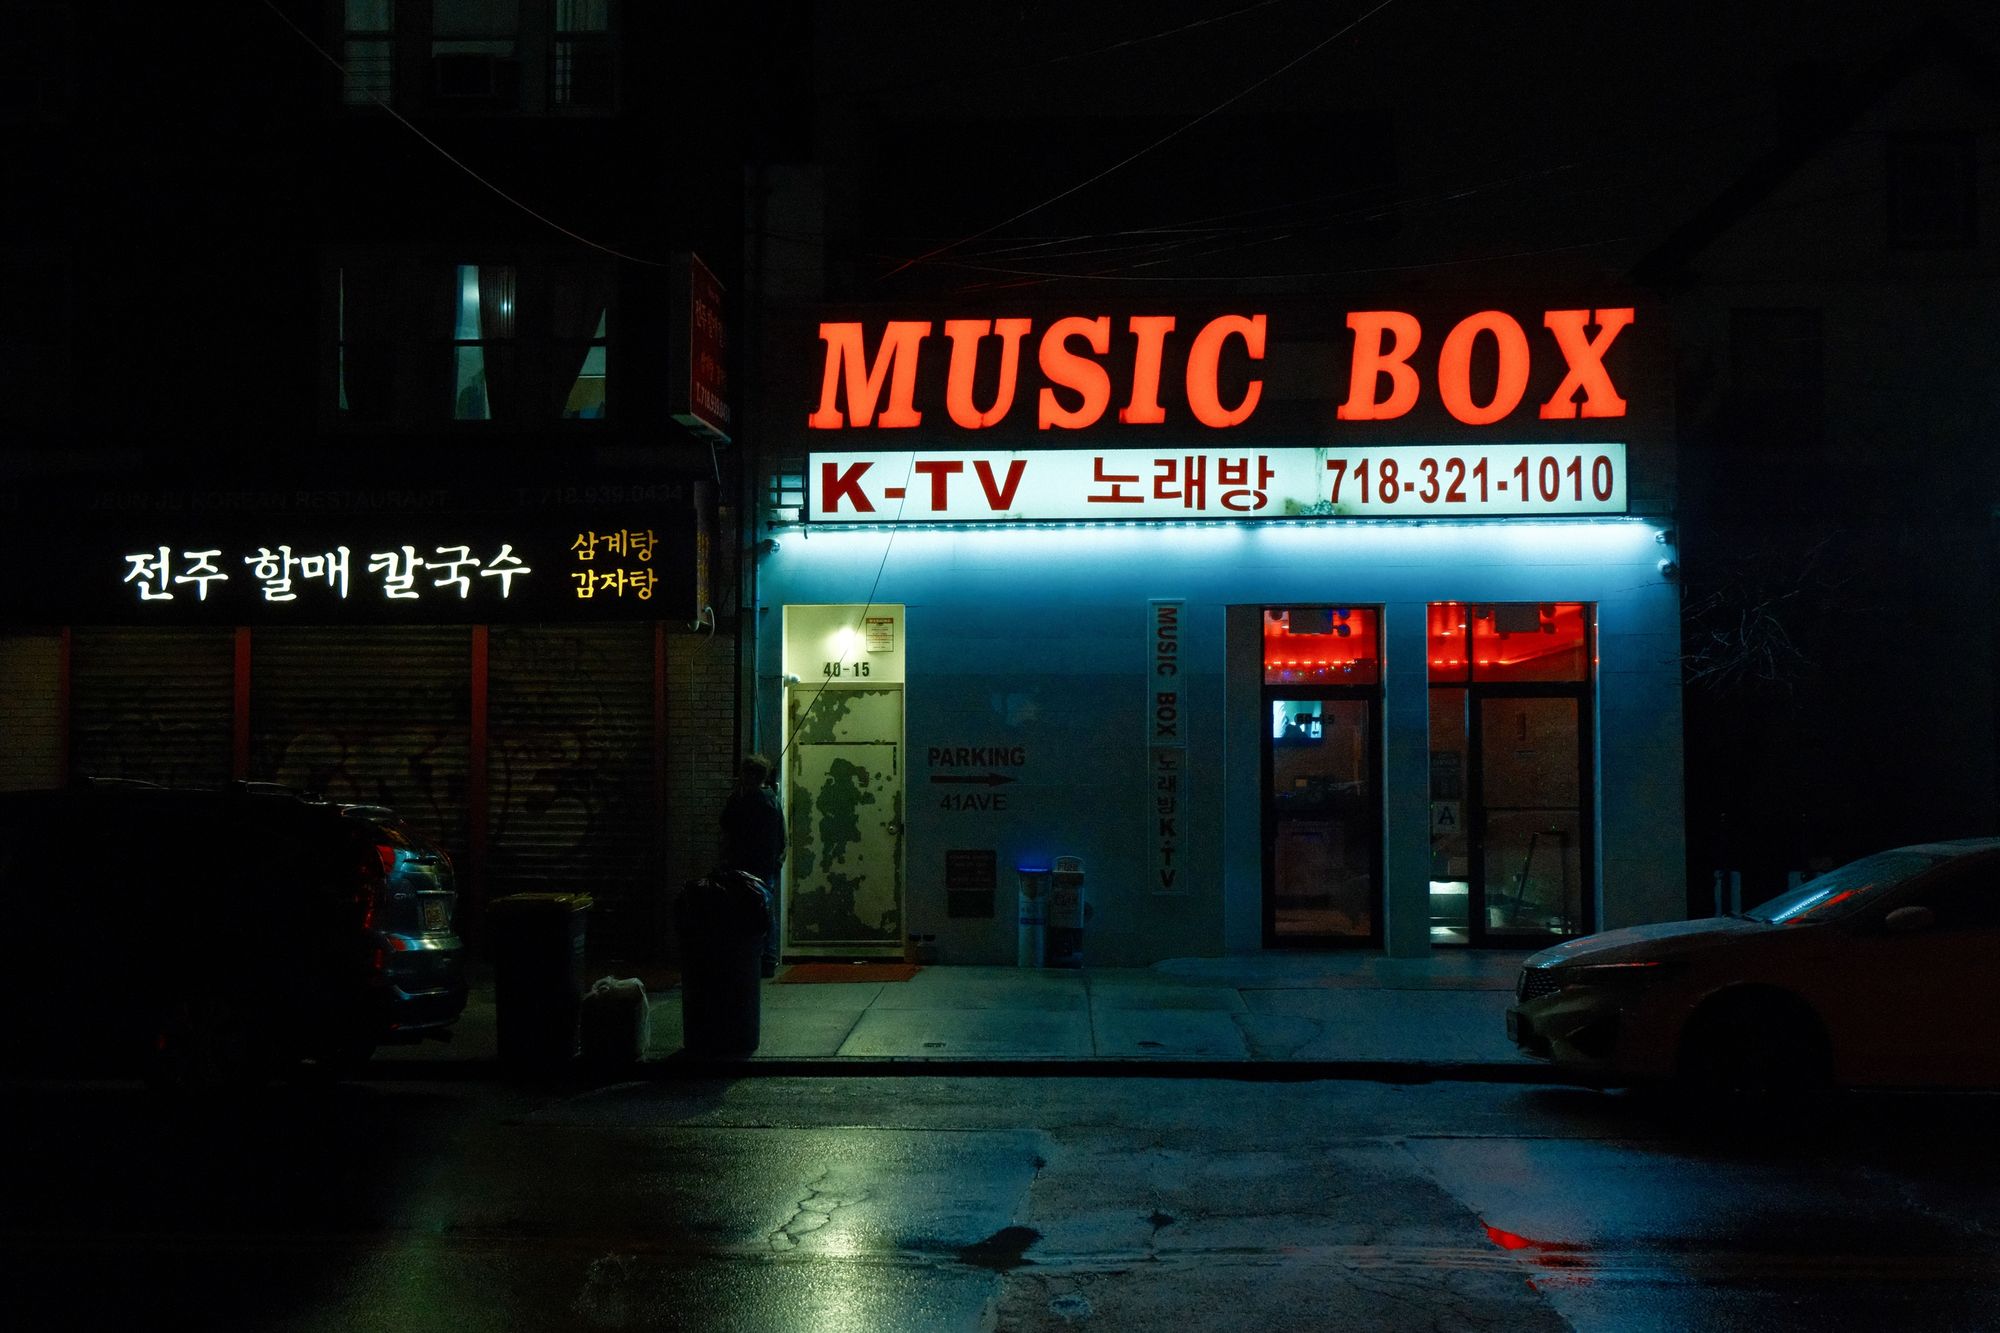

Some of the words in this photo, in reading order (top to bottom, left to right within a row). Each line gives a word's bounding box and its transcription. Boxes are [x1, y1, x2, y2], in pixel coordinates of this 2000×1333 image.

[807, 313, 1268, 431] MUSIC
[1335, 306, 1636, 427] BOX
[295, 489, 447, 508] RESTAURANT
[821, 459, 1028, 513] K-TV
[1087, 455, 1275, 512] 노래방
[1326, 455, 1614, 504] 718-321-1010
[570, 529, 659, 562] 삼계탕
[123, 545, 229, 601] 전주
[244, 545, 351, 601] 할매
[367, 543, 532, 599] 칼국수
[570, 567, 659, 601] 감자탕
[1156, 606, 1178, 677] MUSIC
[823, 661, 870, 677] 40-15
[1156, 691, 1178, 737] BOX
[927, 747, 1025, 768] PARKING
[1157, 753, 1177, 815] 노래방
[1437, 805, 1455, 825] A
